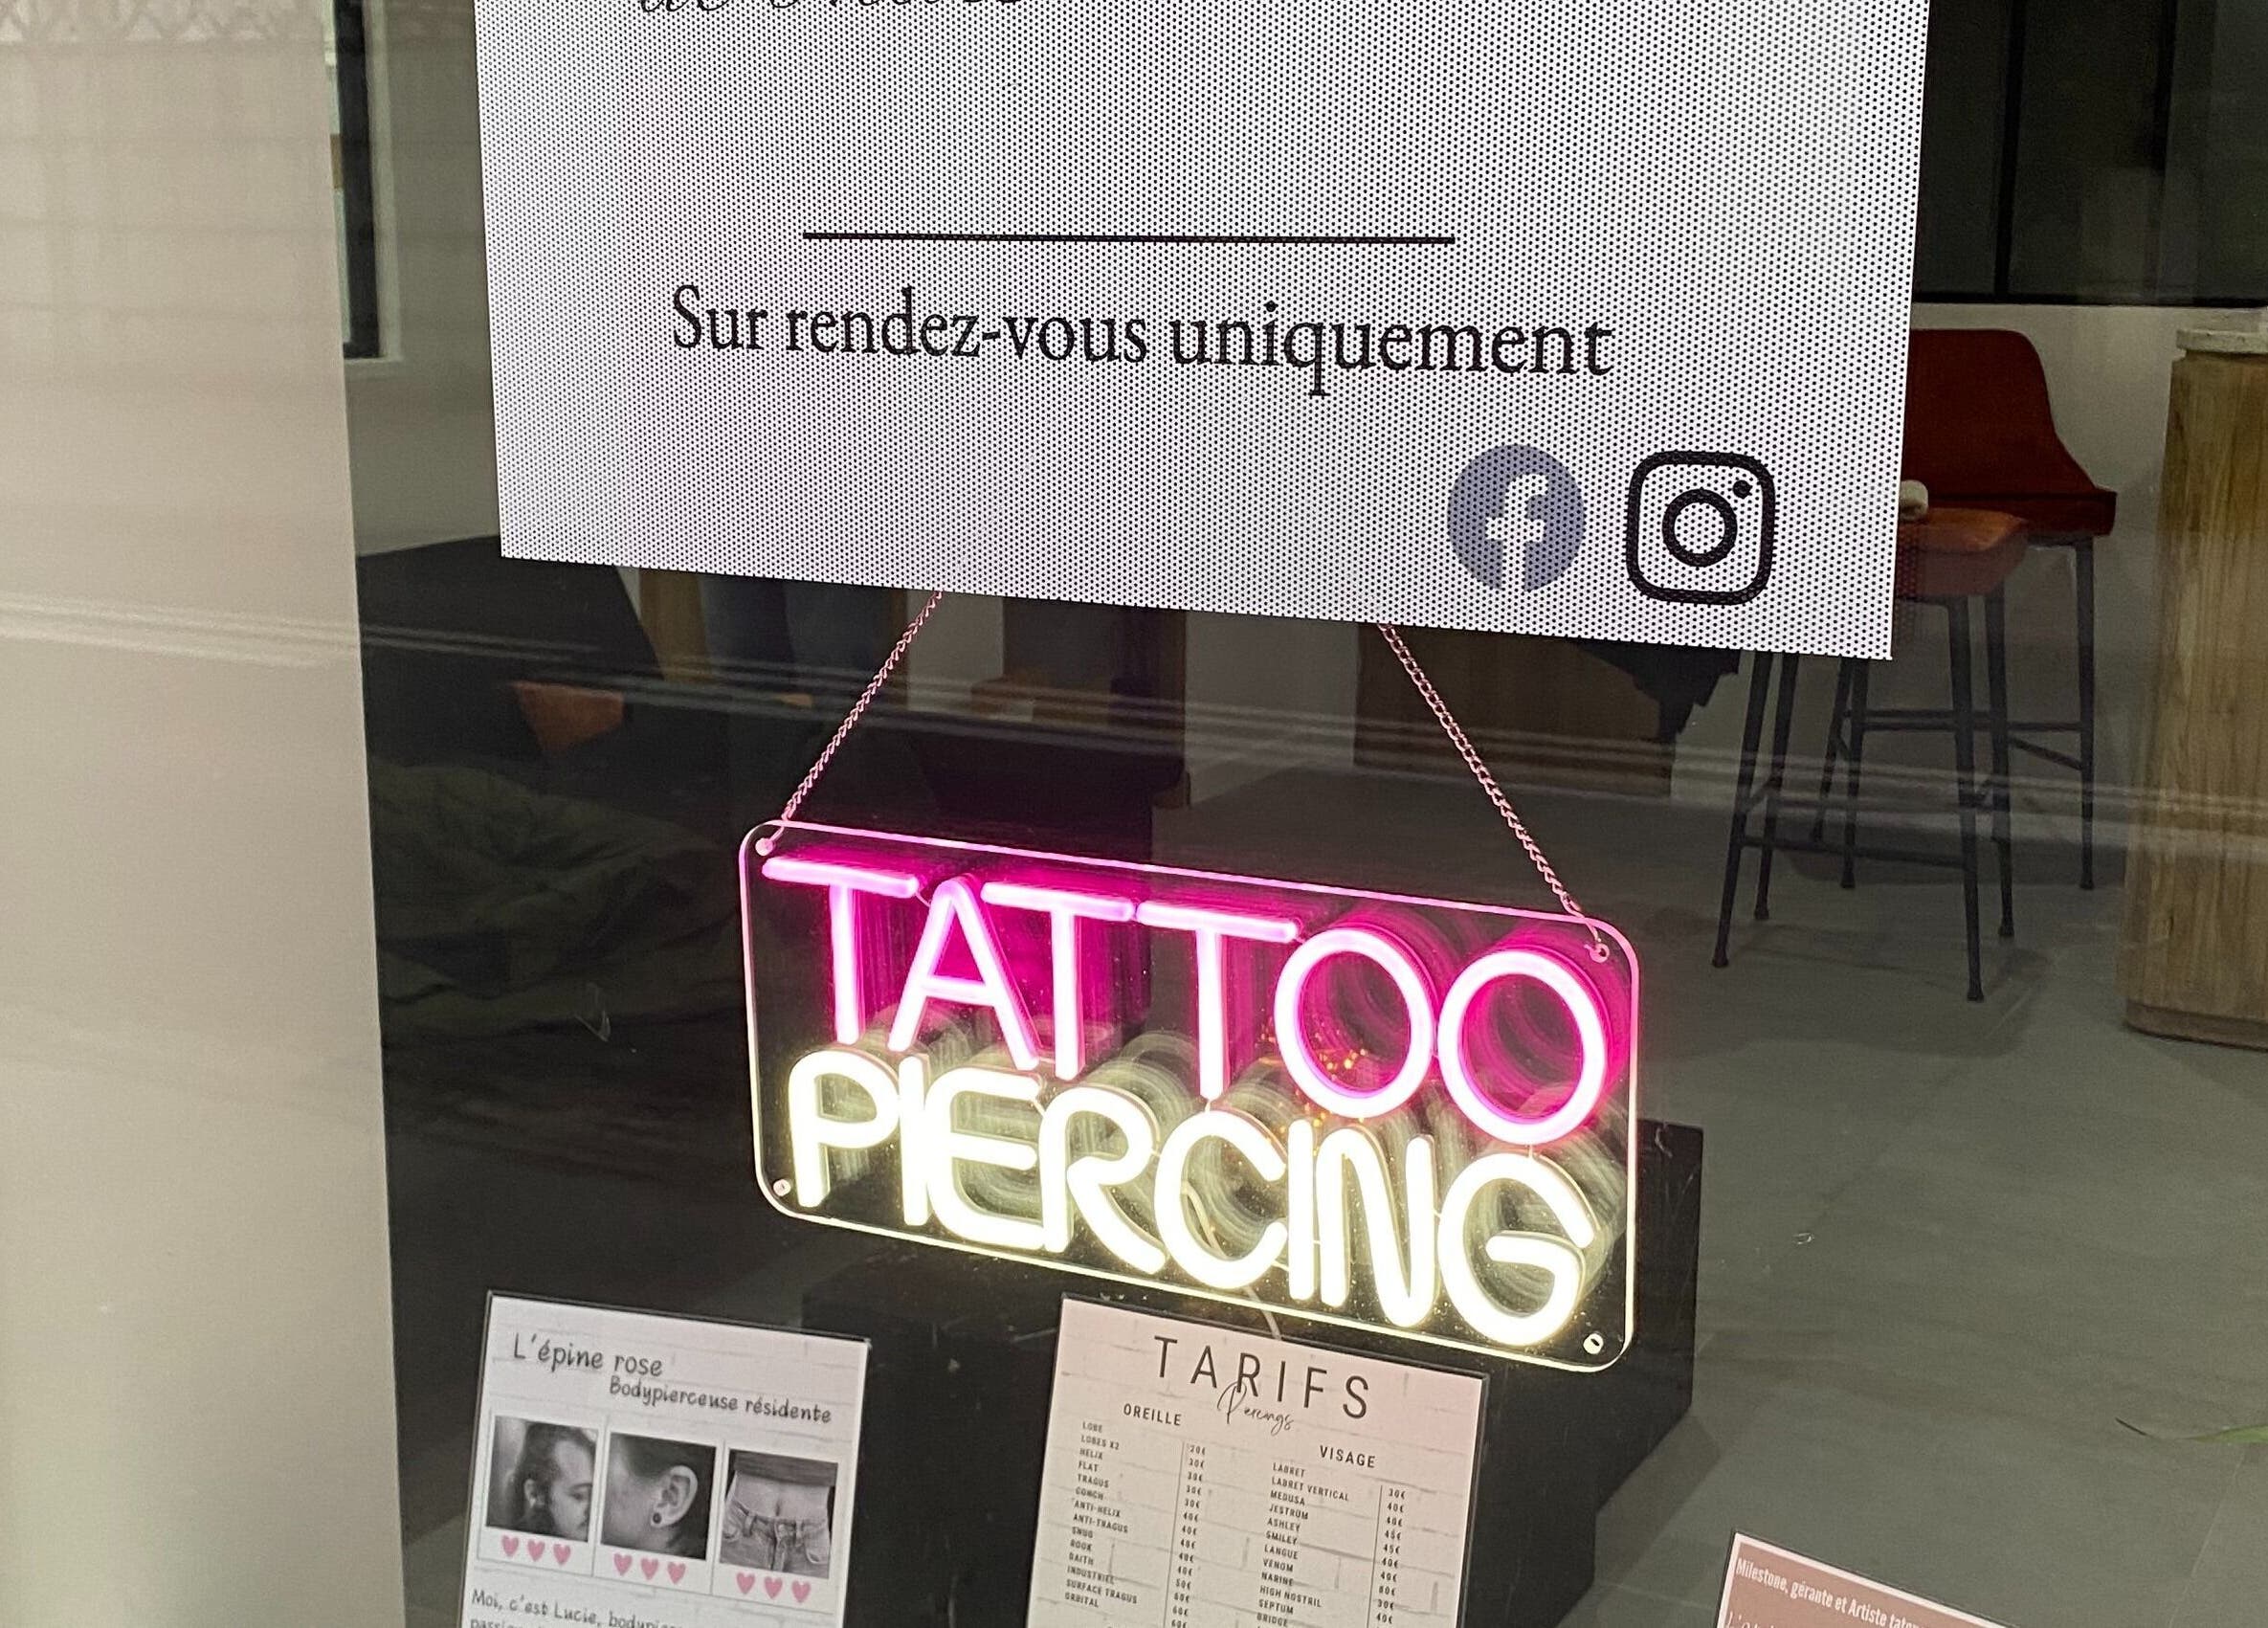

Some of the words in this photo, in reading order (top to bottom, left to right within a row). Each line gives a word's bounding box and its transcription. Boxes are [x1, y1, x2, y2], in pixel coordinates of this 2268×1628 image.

[671, 282, 767, 356] Sur
[786, 285, 1148, 367] rendez-vous
[1171, 300, 1614, 397] uniquement
[761, 856, 1608, 1147] TATTOO
[787, 1049, 1596, 1346] PIERCING
[514, 1331, 604, 1372] L'épine
[613, 1351, 663, 1377] rose
[1154, 1335, 1369, 1419] TARIFS
[609, 1374, 738, 1411] Bodypierceuse
[744, 1396, 832, 1424] résidente
[1123, 1403, 1182, 1426] OREILLE
[1078, 1461, 1099, 1472] FLAT
[1319, 1444, 1376, 1468] VISAGE
[1077, 1473, 1109, 1488] TRAGUS
[1273, 1462, 1305, 1478] LABRET
[1271, 1476, 1303, 1491] LABRET
[1307, 1483, 1349, 1502] VERTICAL
[1271, 1489, 1305, 1505] MEDUSA
[1073, 1514, 1128, 1533] ANTI-TRAGUS
[1267, 1517, 1301, 1532] ASHLEY
[1265, 1530, 1298, 1546] SMILEY
[1264, 1545, 1299, 1560] LANGUE
[1263, 1558, 1294, 1572] VENOM
[1066, 1578, 1101, 1595] SURFACE
[1105, 1588, 1138, 1604] TRAGUS
[1261, 1572, 1294, 1587] NARINE
[1064, 1592, 1099, 1608] ORBITAL
[1259, 1585, 1281, 1598] HIGH
[1284, 1589, 1323, 1608] NOSTRIL
[1736, 1557, 1789, 1596] Milestone,
[1790, 1580, 1834, 1608] gérante
[1834, 1595, 1848, 1615] et
[1848, 1599, 1888, 1627] Artiste
[471, 1588, 503, 1612] Moi,
[509, 1593, 548, 1617] c'est
[554, 1602, 601, 1627] Lucie,
[1258, 1598, 1294, 1615] SEPTUM
